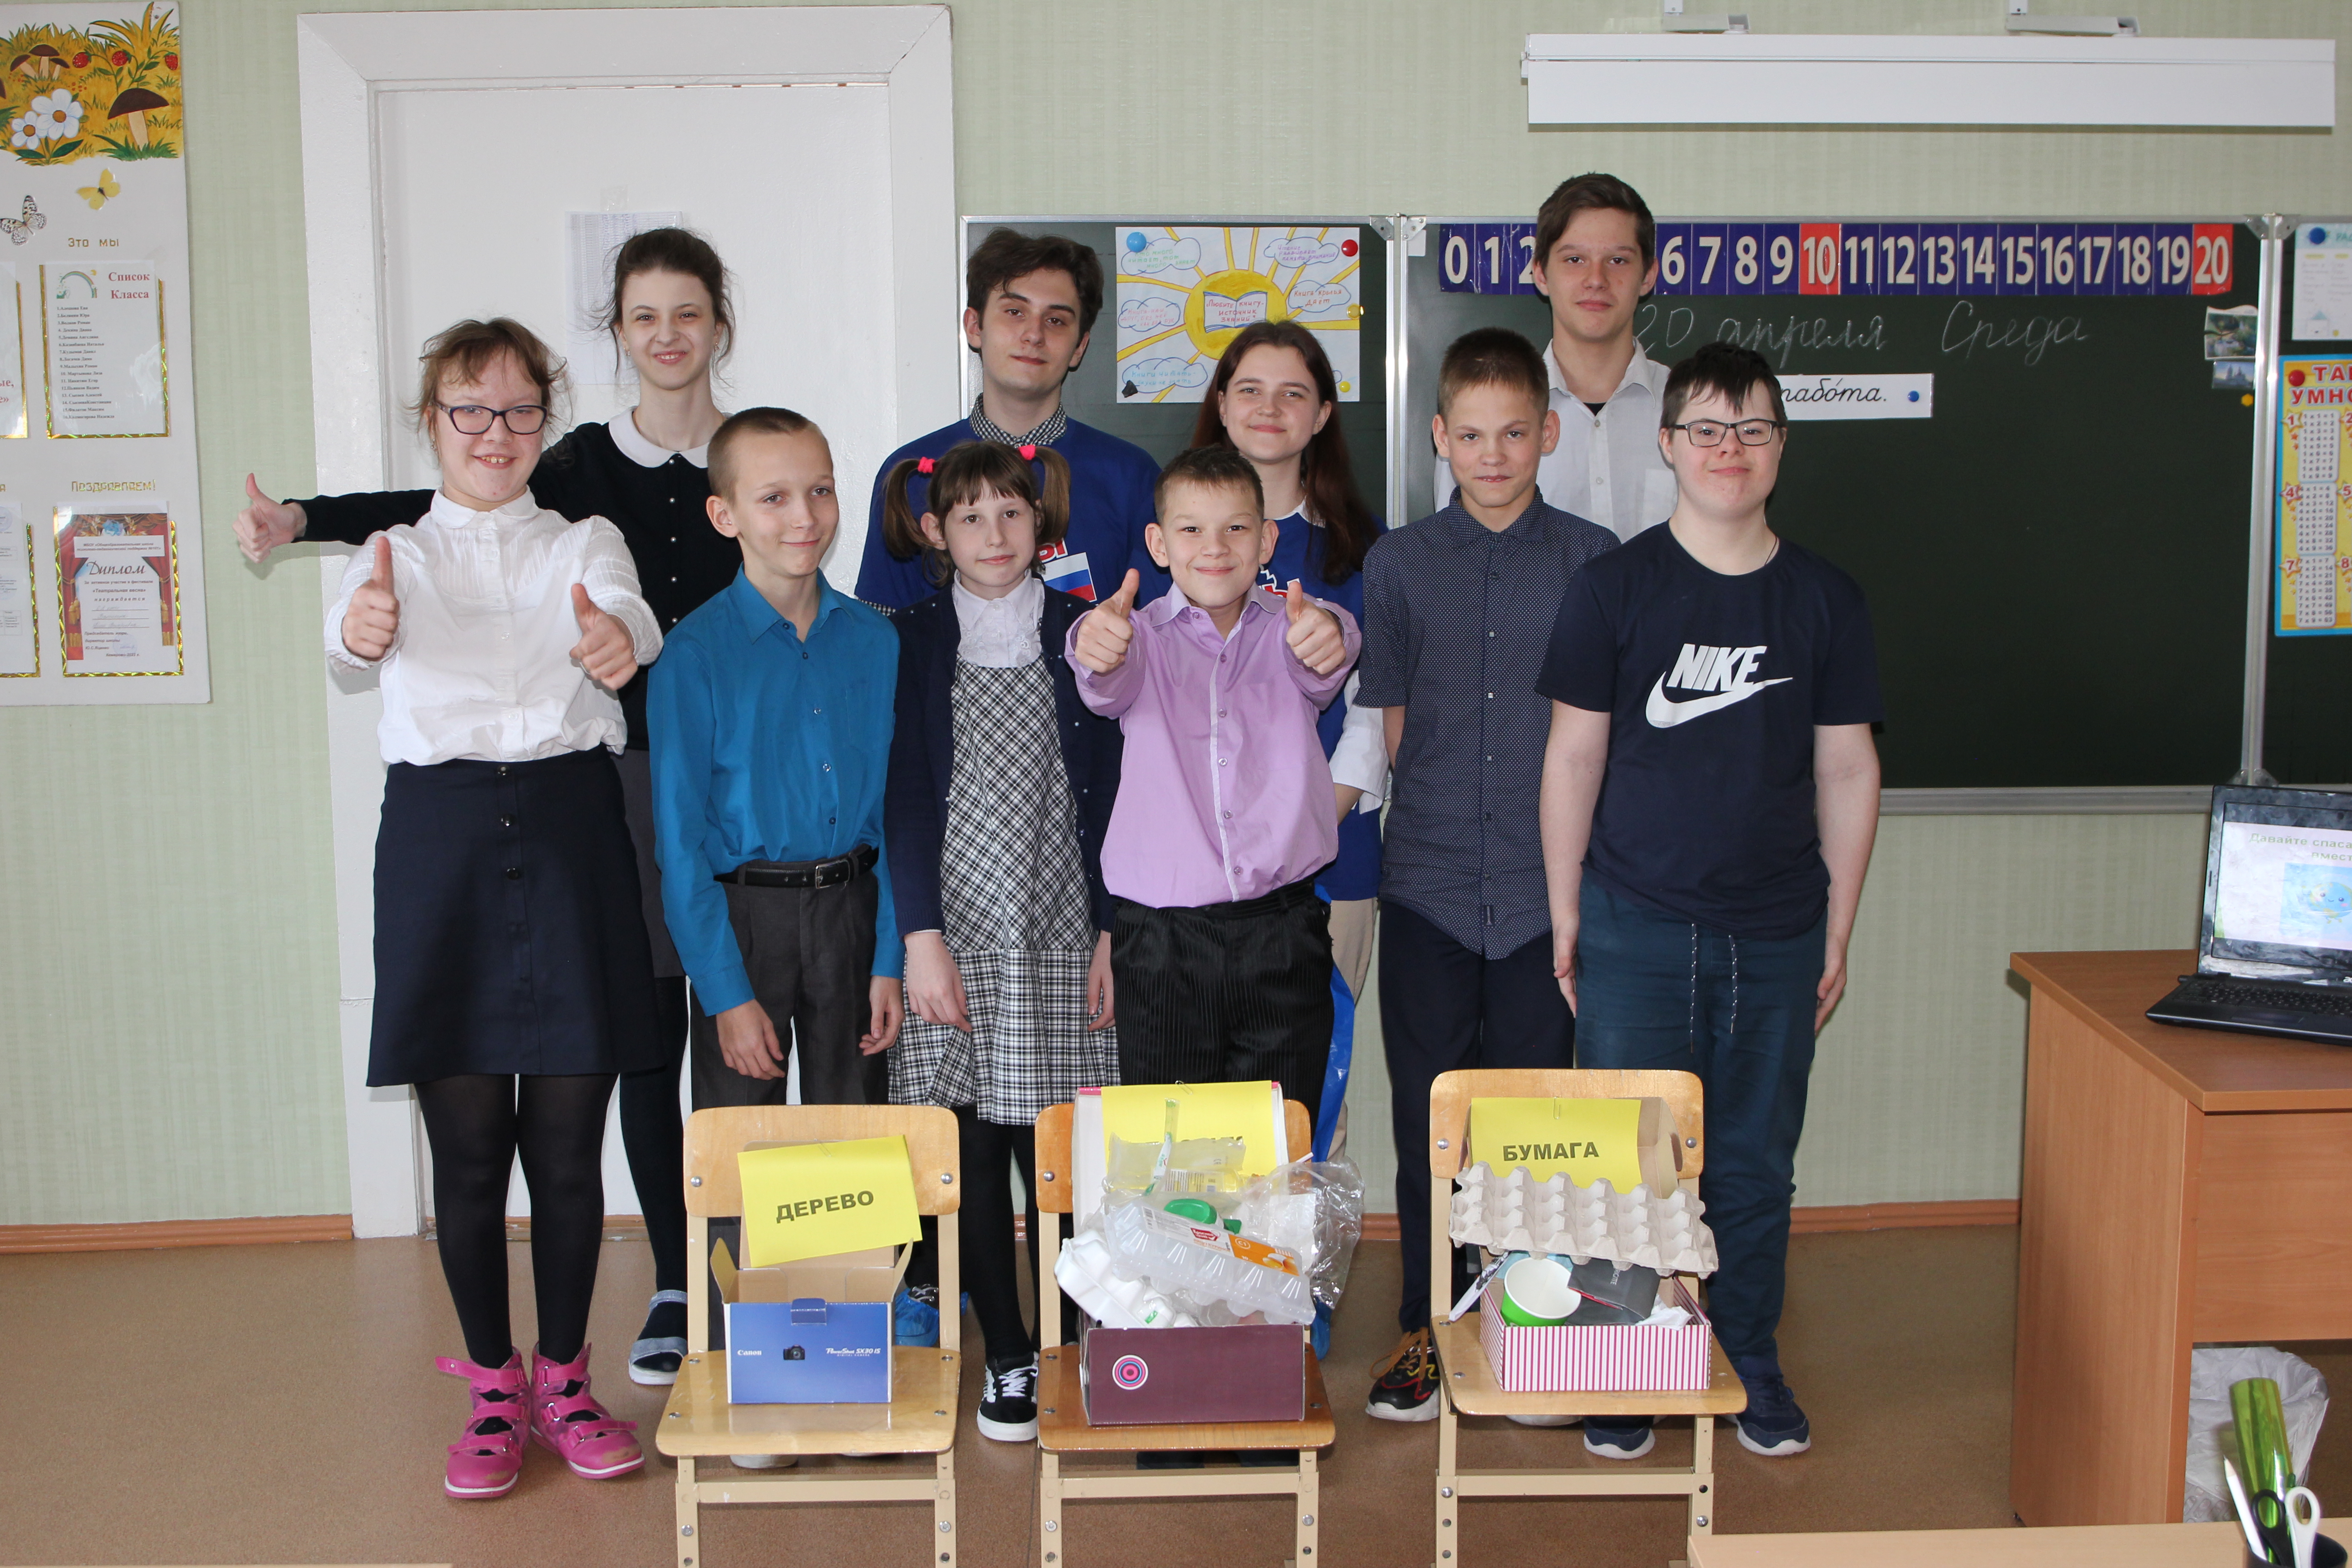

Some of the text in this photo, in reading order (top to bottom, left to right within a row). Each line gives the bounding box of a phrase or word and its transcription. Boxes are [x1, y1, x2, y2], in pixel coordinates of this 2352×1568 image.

[68, 238, 89, 247] Это
[1445, 236, 2230, 284] 0 1 2 6 7 8 9 10 11 12 13 14 15 16 17 18 19 20
[108, 272, 150, 281] Список
[111, 290, 149, 299] Класса
[1636, 299, 2092, 369] 20 апреля Среда
[2288, 415, 2294, 425] 1
[2286, 488, 2293, 497] 4
[2343, 485, 2351, 496] 5
[87, 560, 146, 575] Диплом
[2286, 560, 2294, 570] 7
[2342, 558, 2349, 568] 8
[1666, 643, 1768, 691] NIKE
[2249, 833, 2308, 845] Давайте
[1503, 1142, 1599, 1161] БУМАГА
[776, 1191, 874, 1224] ДЕРЕВО
